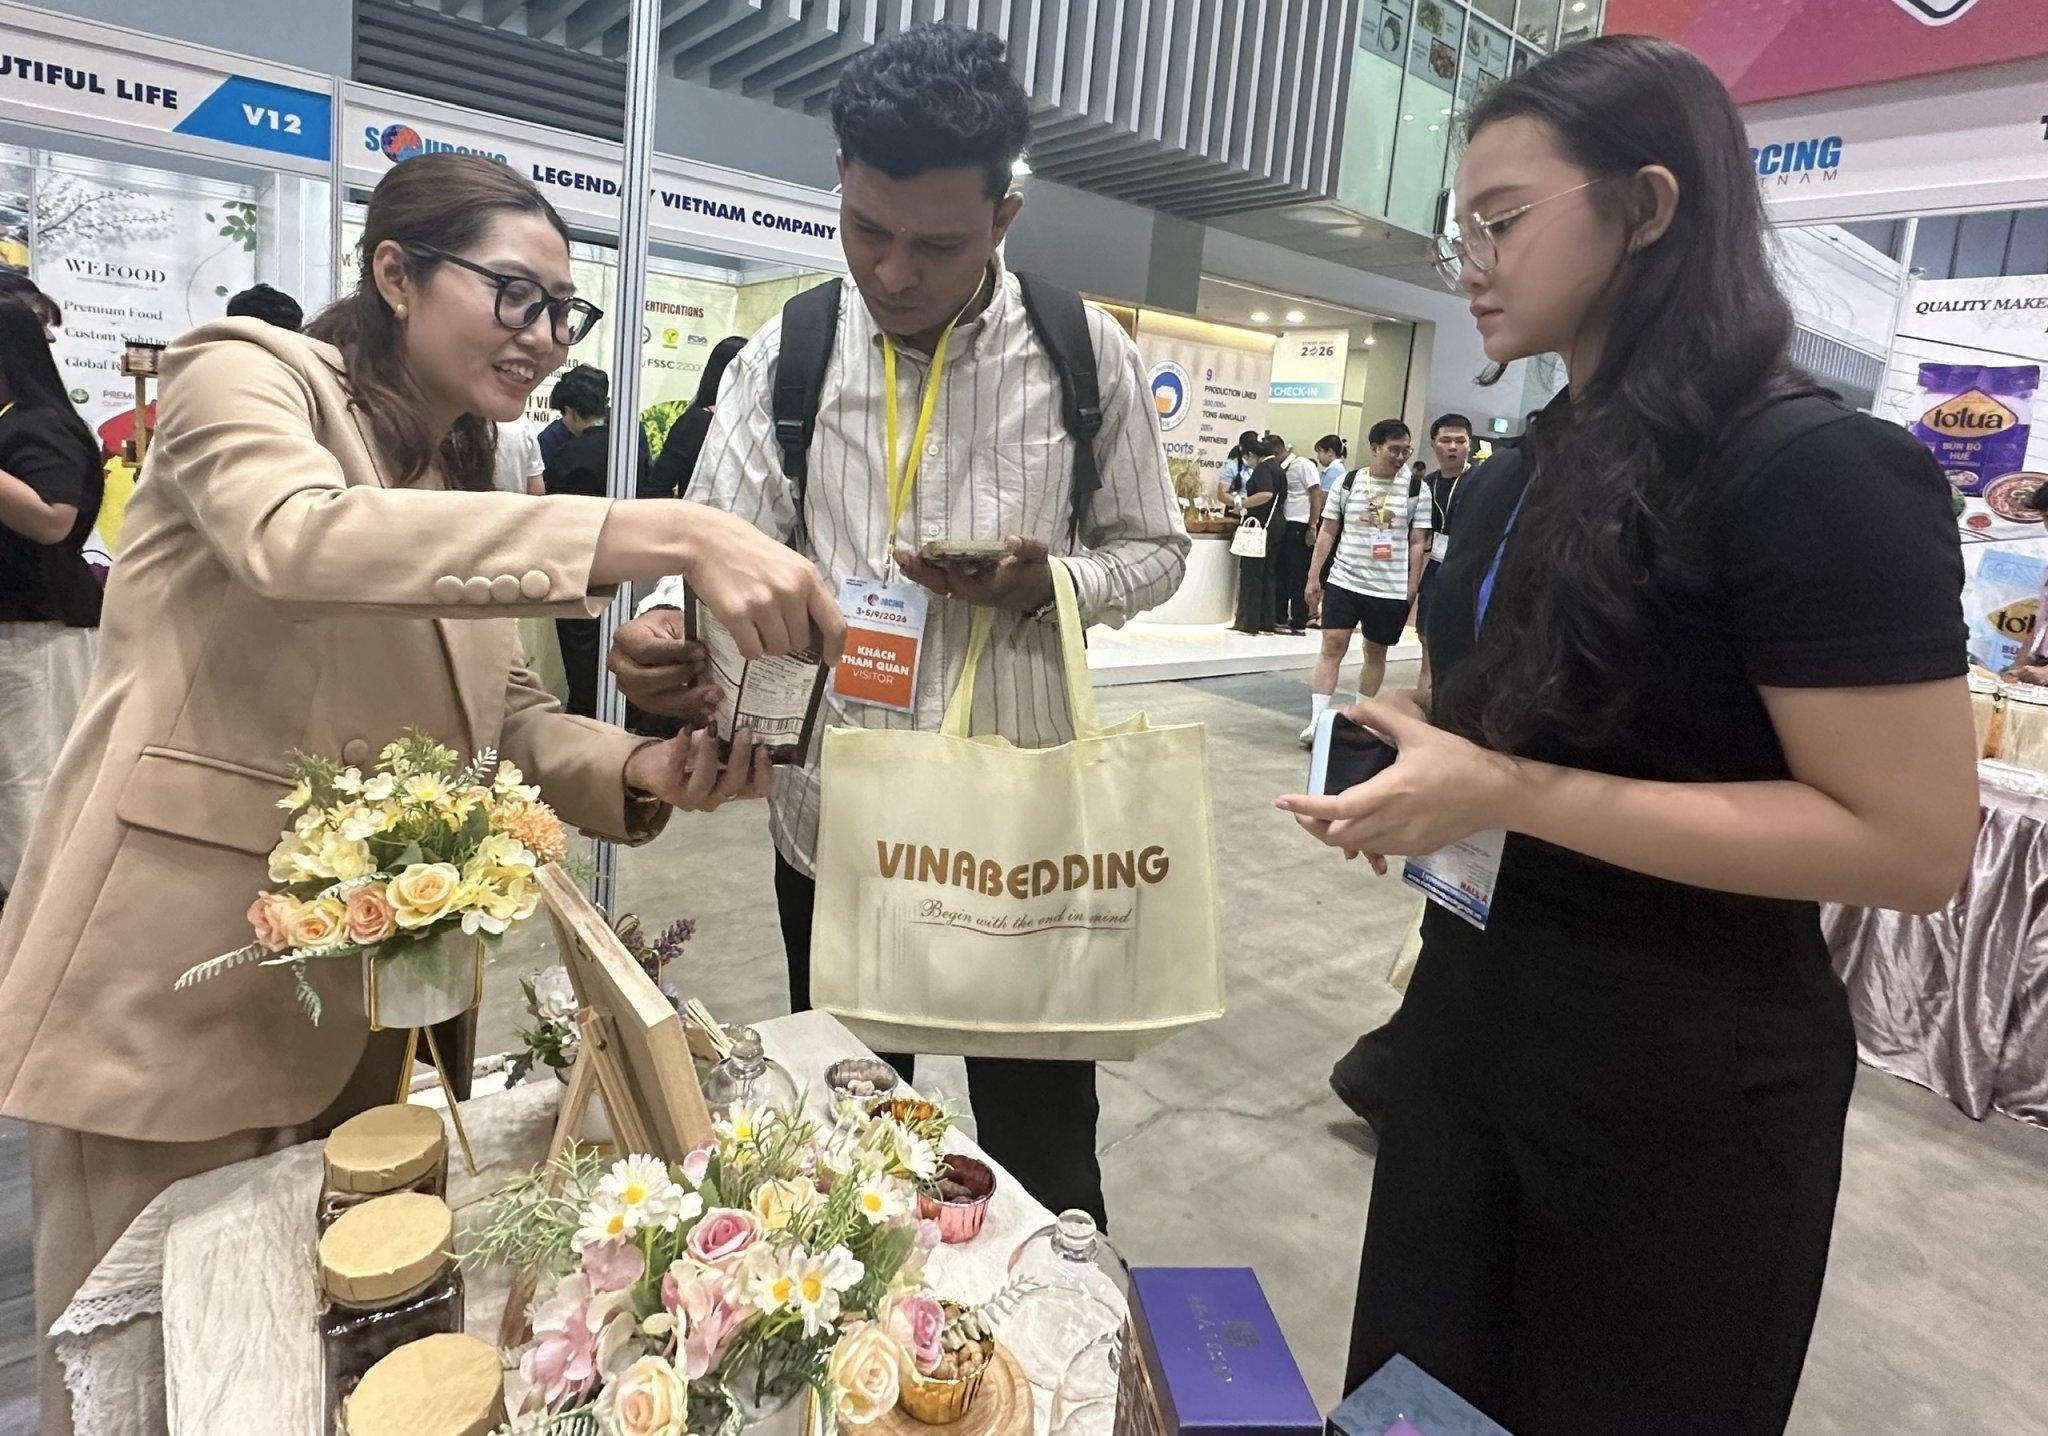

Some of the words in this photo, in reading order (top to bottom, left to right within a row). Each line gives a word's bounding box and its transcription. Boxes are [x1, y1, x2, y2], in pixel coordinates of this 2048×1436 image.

[116, 78, 178, 110] LIFE
[242, 103, 302, 135] V12
[532, 164, 656, 201] LEGEND
[660, 191, 746, 223] VIETNAM
[751, 210, 837, 240] COMPANY
[63, 300, 126, 317] Premium
[129, 307, 163, 321] Food
[1915, 300, 1993, 316] QUALITY
[1993, 297, 2048, 311] MAKE
[64, 327, 116, 342] Custom
[64, 357, 107, 370] Global
[647, 358, 675, 370] FSSC
[1206, 368, 1213, 381] 9
[1273, 386, 1318, 397] CHECK-IN
[1199, 435, 1228, 445] PARTNERS
[841, 655, 873, 669] THAM
[875, 660, 910, 676] QUAN
[852, 668, 895, 685] VISITOR
[877, 840, 1169, 900] VINABEDDING
[919, 898, 972, 926] Begin
[976, 913, 1008, 929] with
[1011, 913, 1033, 930] the
[1067, 908, 1084, 922] in
[1088, 908, 1133, 924] mind
